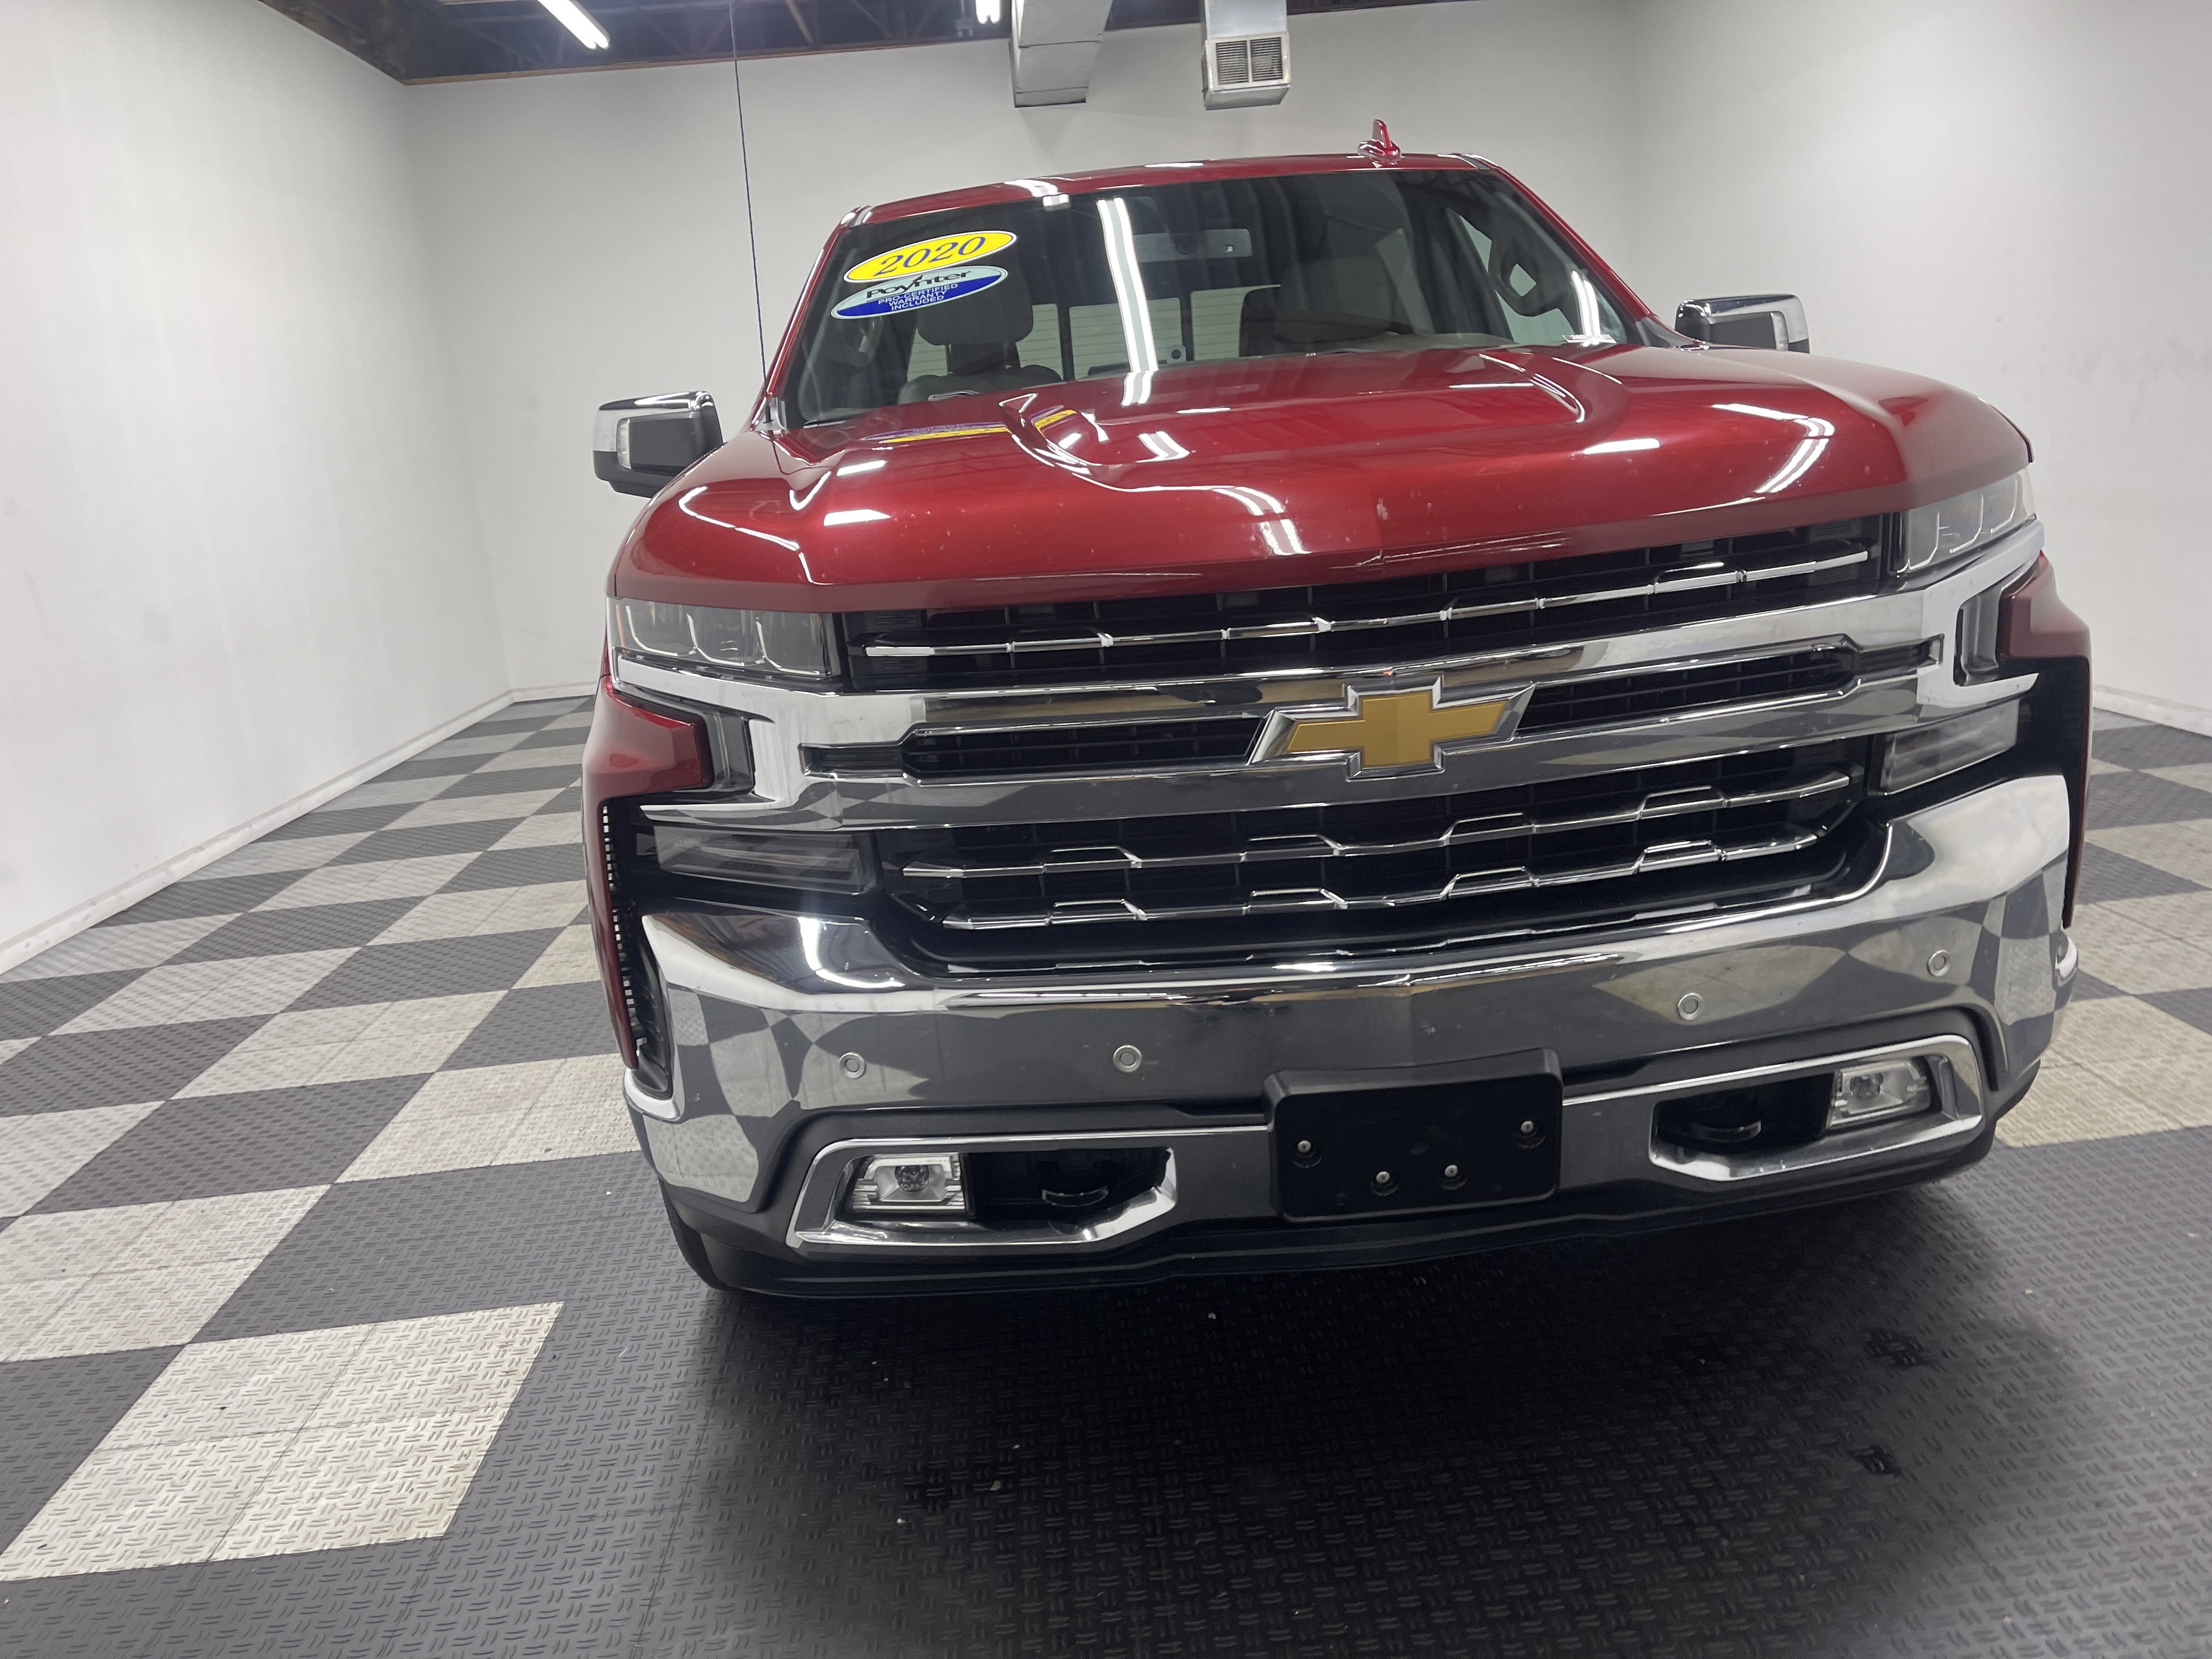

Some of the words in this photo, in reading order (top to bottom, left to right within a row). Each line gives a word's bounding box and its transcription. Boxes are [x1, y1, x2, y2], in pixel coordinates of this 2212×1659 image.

[873, 236, 986, 277] 2020
[878, 283, 958, 305] PRO-CERTIFIED
[888, 290, 947, 307] WARRANTY
[891, 295, 944, 311] INCLUDED
